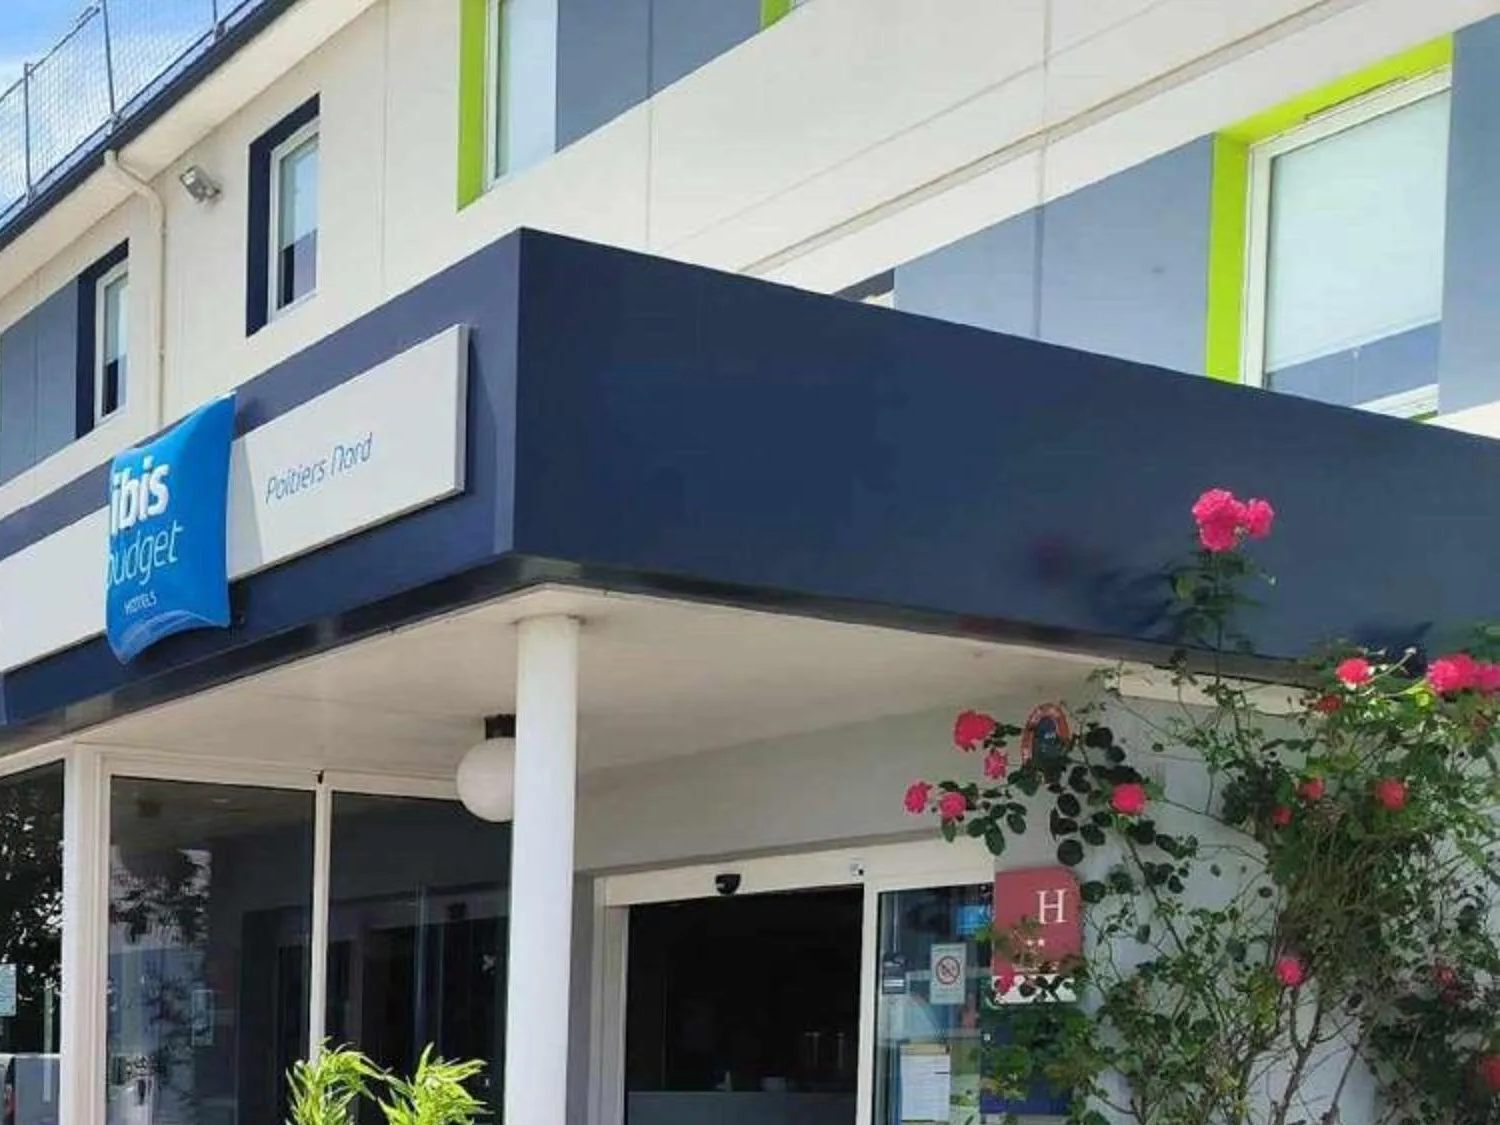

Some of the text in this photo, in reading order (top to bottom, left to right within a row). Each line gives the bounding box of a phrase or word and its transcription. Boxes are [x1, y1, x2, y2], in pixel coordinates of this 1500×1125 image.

[111, 456, 168, 535] ibis
[266, 432, 372, 503] Poitiers Nord
[1037, 888, 1068, 924] H
